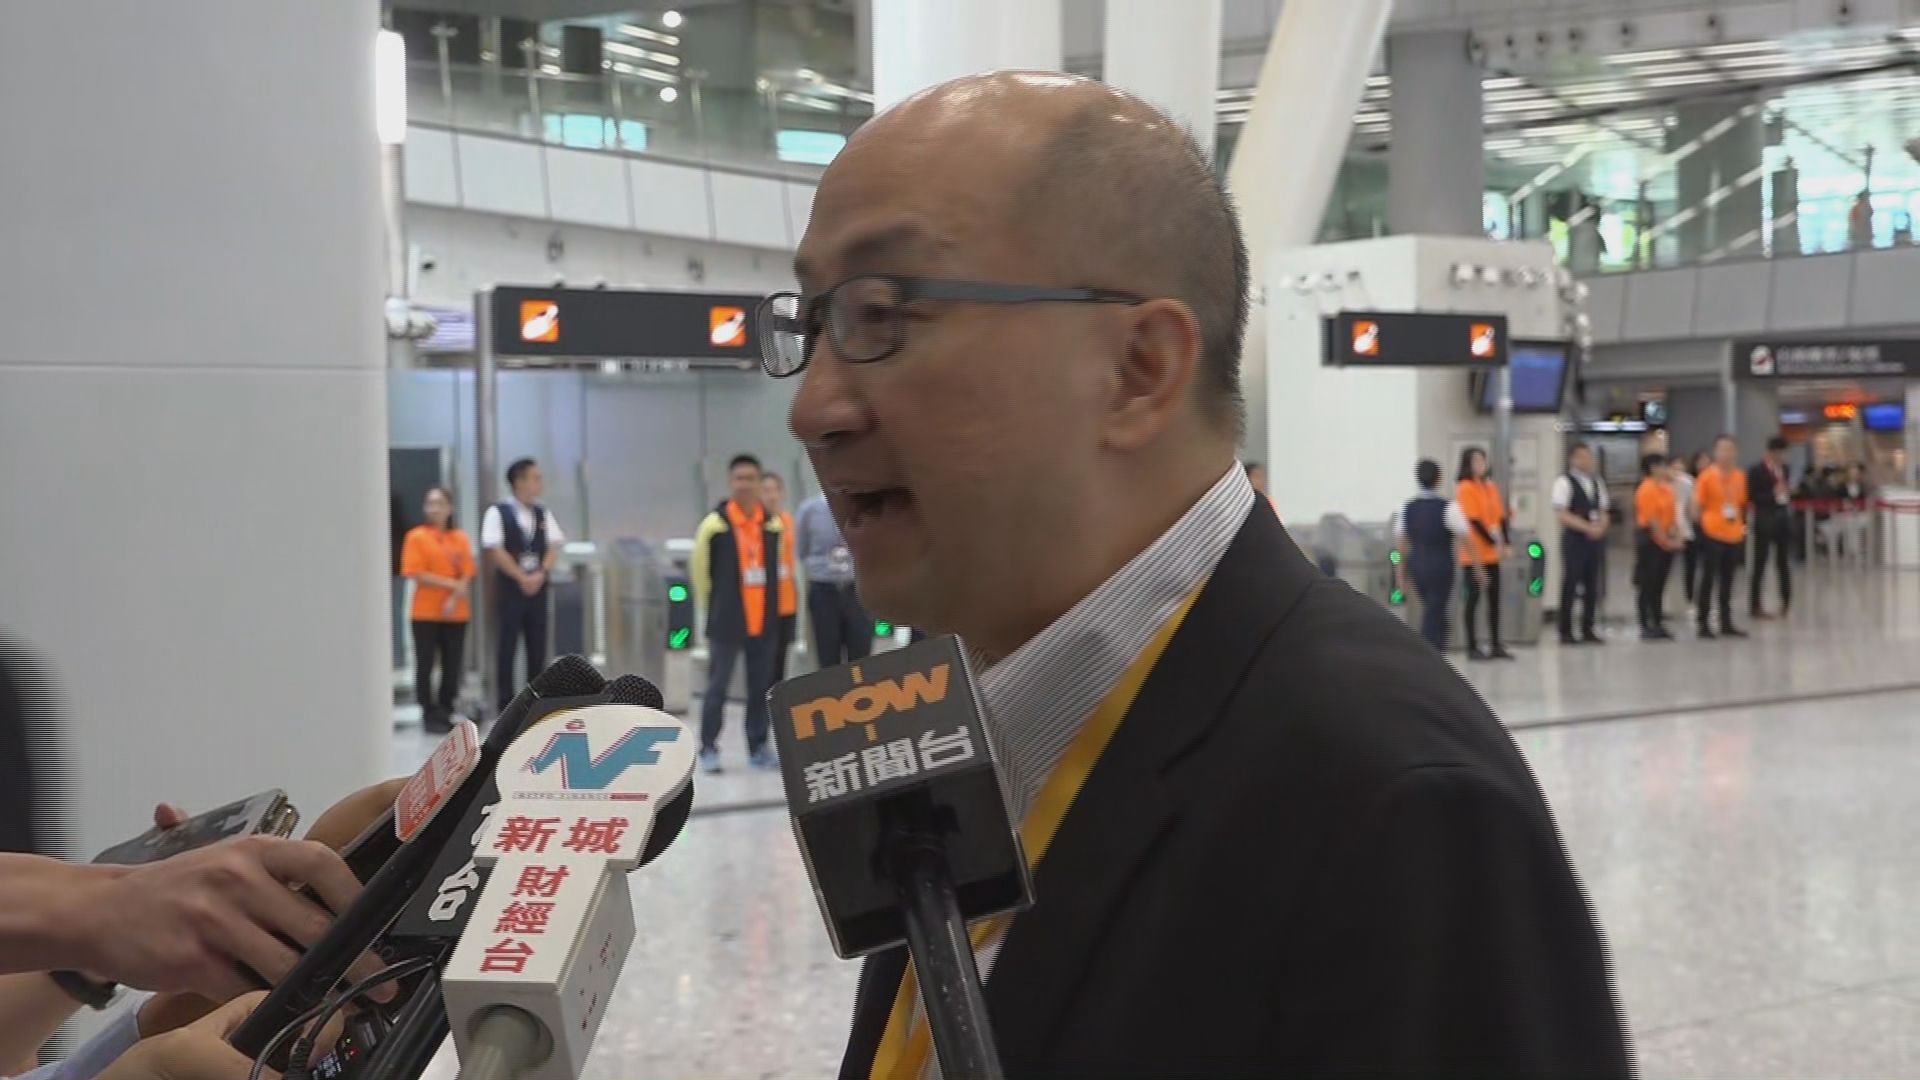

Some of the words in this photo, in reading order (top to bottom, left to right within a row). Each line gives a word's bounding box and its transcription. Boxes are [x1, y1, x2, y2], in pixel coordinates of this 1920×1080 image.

[790, 663, 950, 740] now
[803, 725, 975, 803] 新聞台
[493, 815, 630, 854] 新城
[479, 864, 570, 974] 財經台
